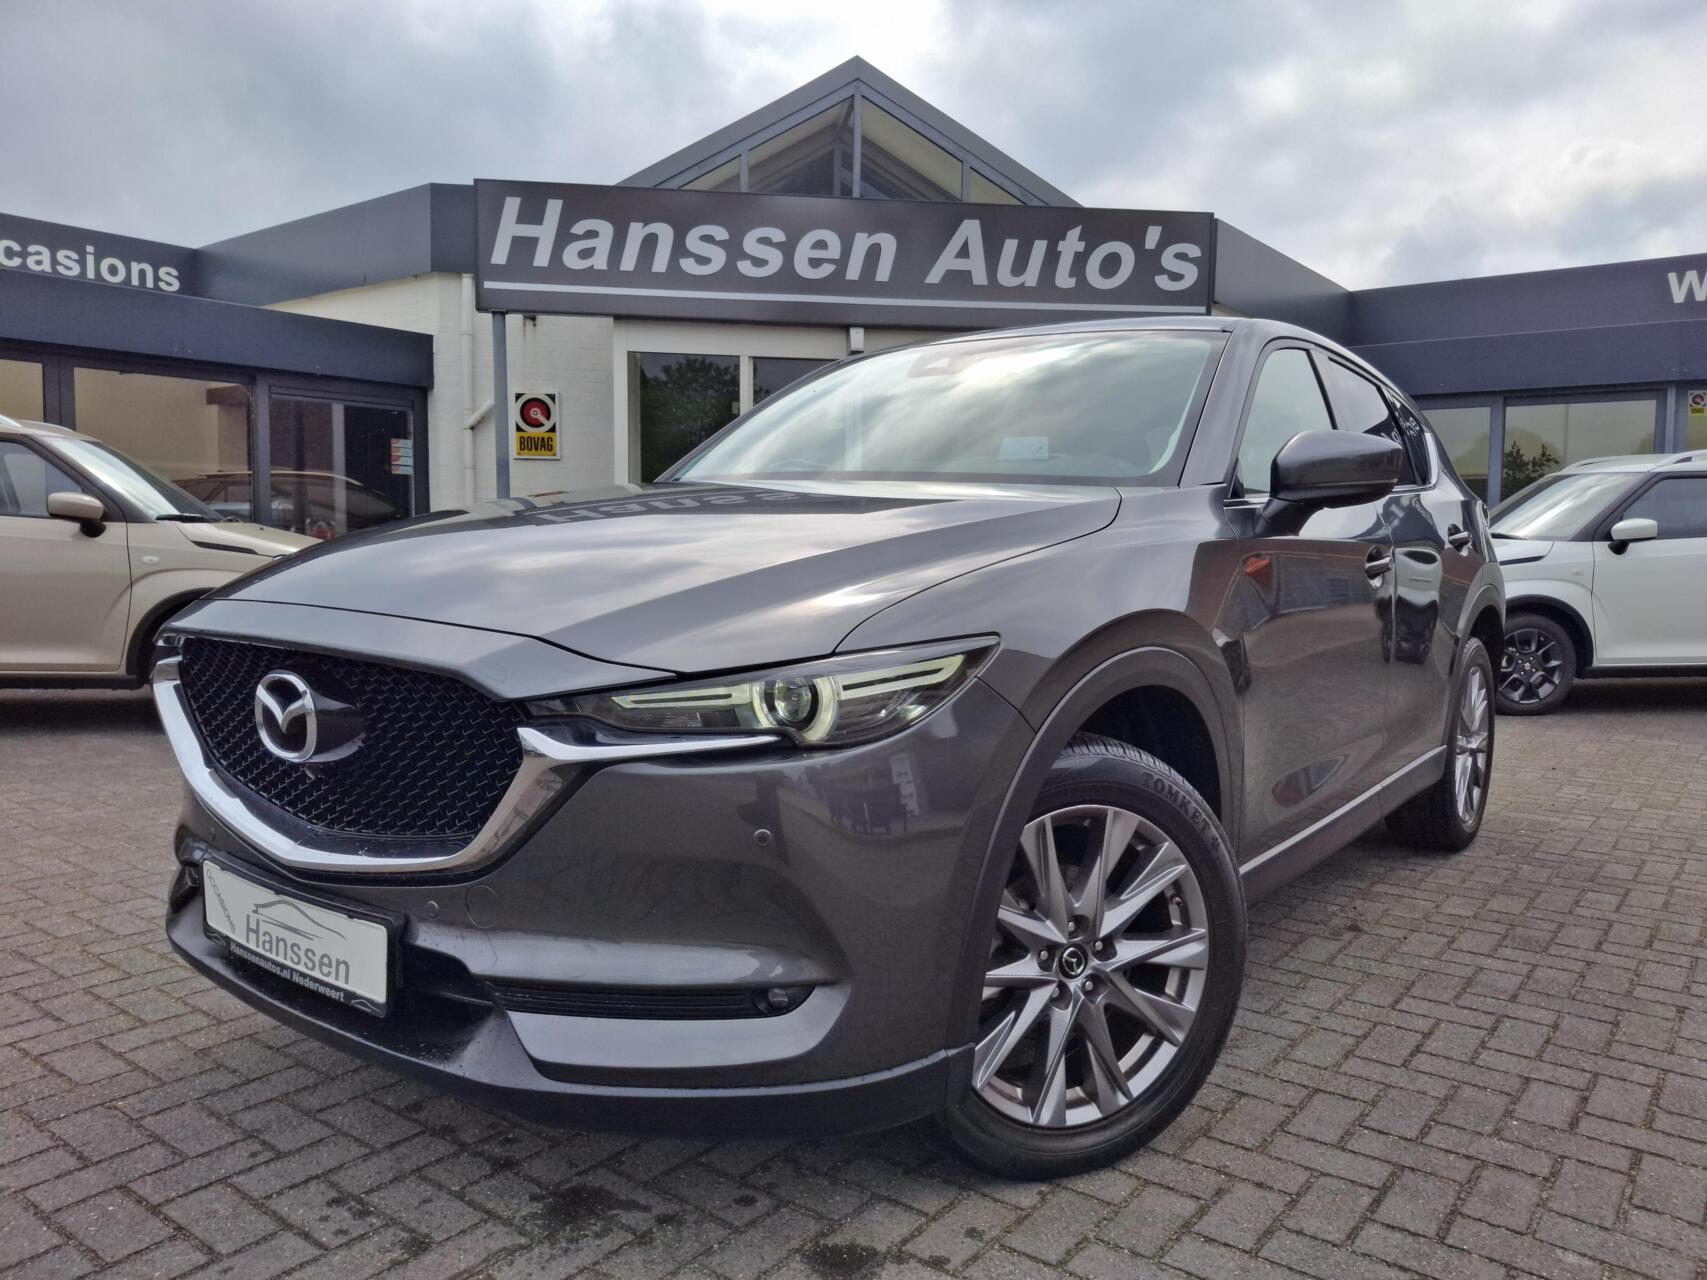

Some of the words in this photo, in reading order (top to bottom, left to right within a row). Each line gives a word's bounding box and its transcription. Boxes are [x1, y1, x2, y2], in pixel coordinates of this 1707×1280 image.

[0, 239, 180, 292] casions
[490, 196, 898, 283] Hanssen
[924, 219, 1202, 292] Auto's
[519, 435, 553, 452] BOVAG
[245, 913, 350, 985] Hanssen
[292, 971, 345, 1002] Nederweert
